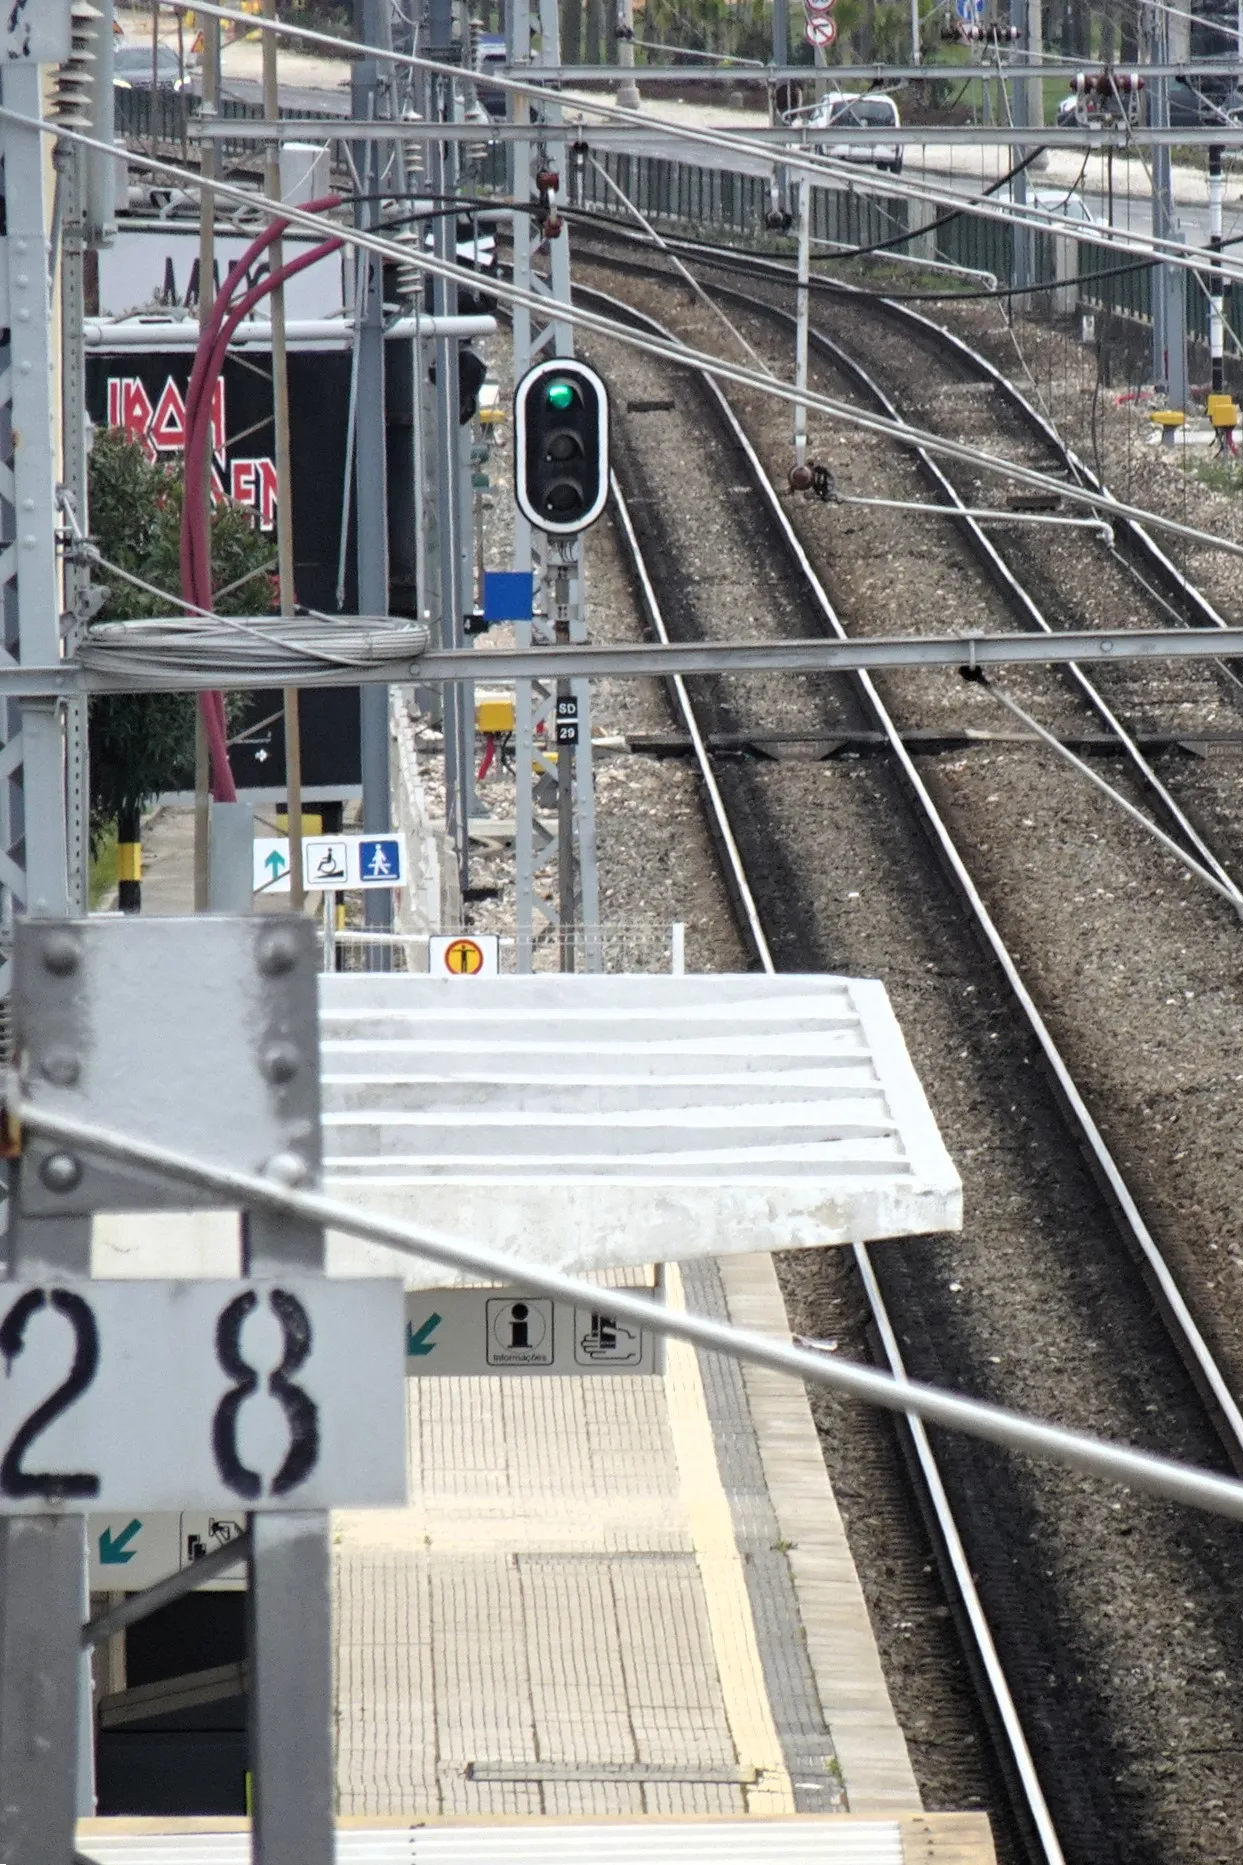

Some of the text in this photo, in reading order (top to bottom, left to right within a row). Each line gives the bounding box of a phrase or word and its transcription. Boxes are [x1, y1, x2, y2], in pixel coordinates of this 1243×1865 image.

[558, 703, 576, 714] SD
[559, 728, 575, 739] 29
[0, 1288, 319, 1498] 28
